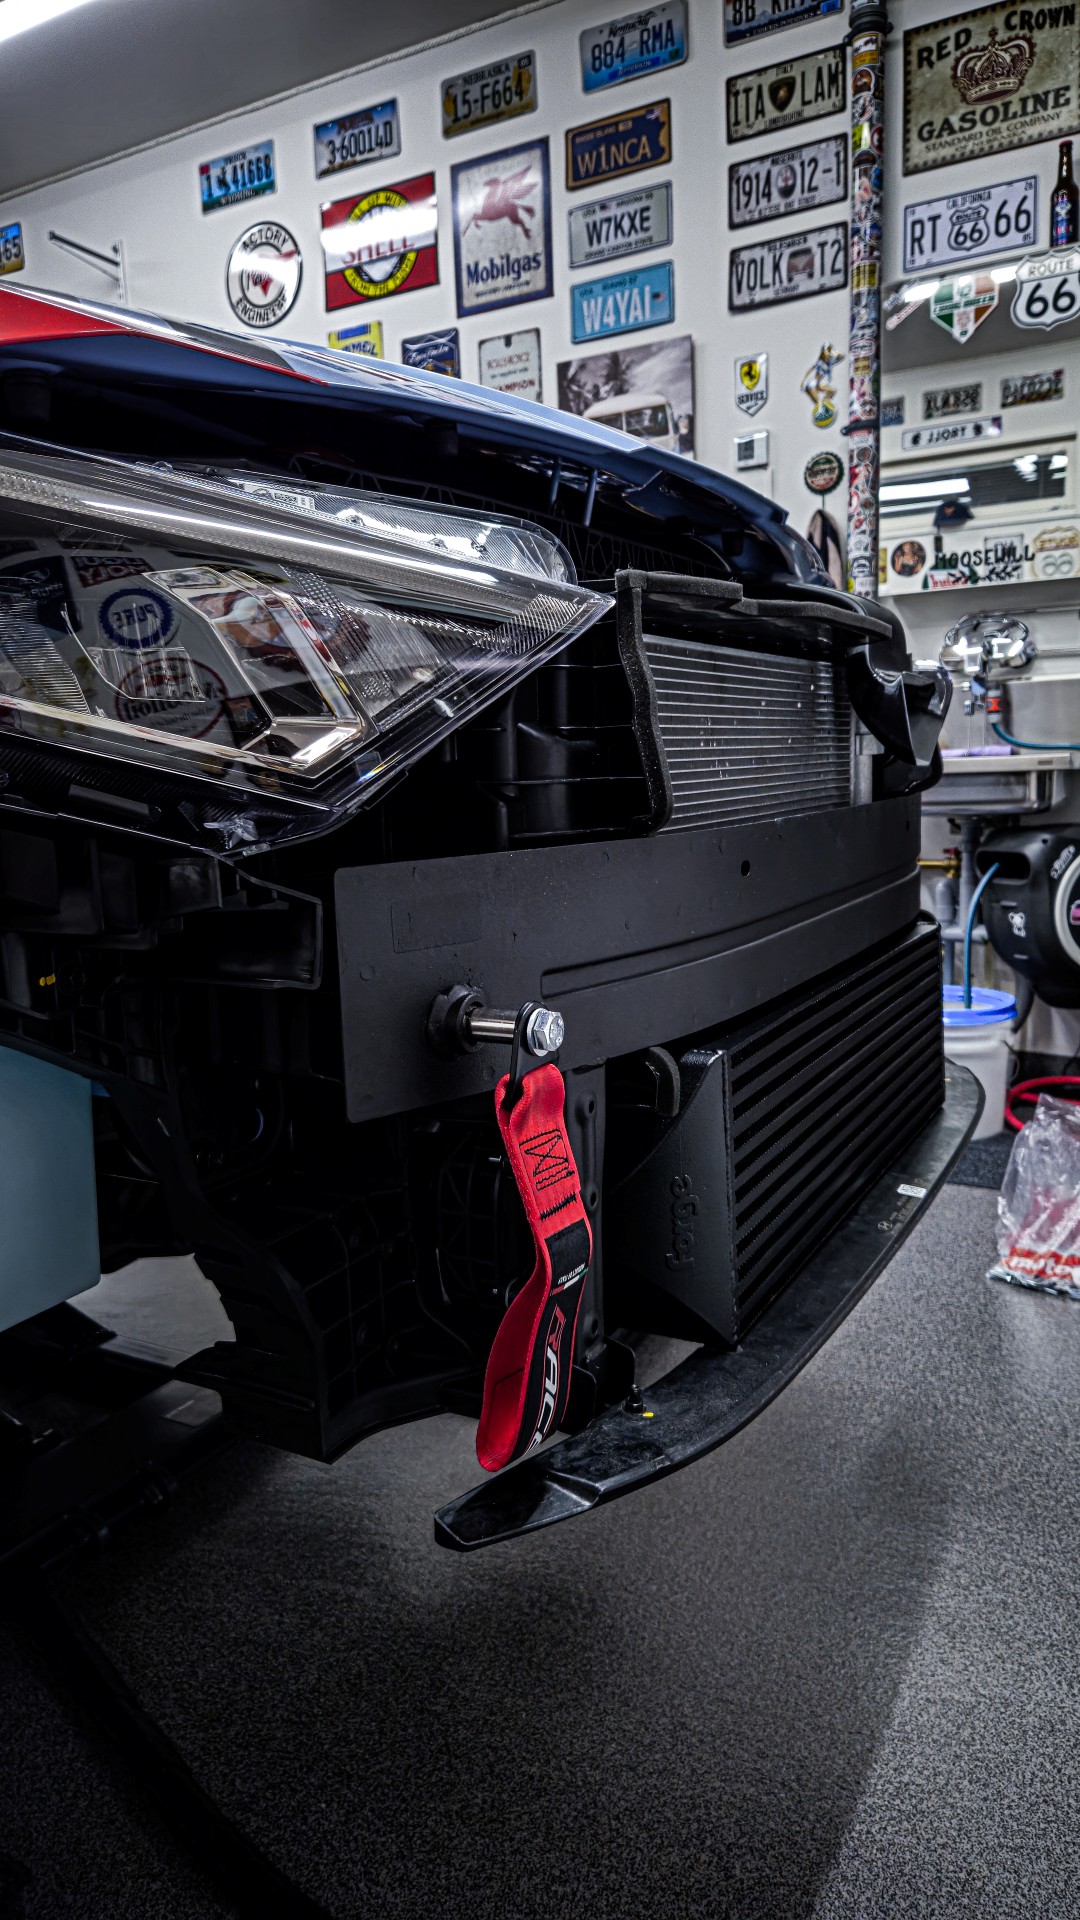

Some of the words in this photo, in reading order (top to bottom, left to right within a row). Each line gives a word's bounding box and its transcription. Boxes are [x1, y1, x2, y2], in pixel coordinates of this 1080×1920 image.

[591, 36, 625, 74] 884
[640, 18, 675, 57] RMA
[917, 28, 973, 70] RED
[1004, 4, 1076, 33] CROWN
[463, 63, 510, 85] NEBRASKA
[732, 84, 766, 127] ITA
[801, 61, 840, 107] LAM
[452, 71, 525, 124] 15-F664
[917, 85, 1072, 143] GASOLINE
[327, 120, 394, 165] 3-60014D
[924, 131, 984, 151] STANDARD
[985, 125, 1002, 139] OIL
[1006, 110, 1063, 132] COMPANY
[577, 134, 652, 178] W1NCA
[735, 168, 772, 213] 1914
[800, 150, 842, 196] 12-1
[946, 190, 993, 210] CALIFORNIA
[585, 205, 652, 248] W7KXE
[910, 215, 942, 257] RT
[994, 195, 1032, 238] 66
[954, 210, 983, 222] ROUTE
[954, 222, 983, 246] 66
[0, 236, 21, 263] 65
[242, 226, 290, 251] ACTORY
[466, 252, 542, 285] Mobilgas
[735, 251, 784, 295] VOLK
[817, 239, 843, 279] T2
[1028, 258, 1074, 278] ROUTE
[582, 284, 651, 334] W4YAI
[1025, 277, 1077, 319] 66
[737, 389, 765, 406] SERVICE
[665, 1173, 700, 1272] forge
